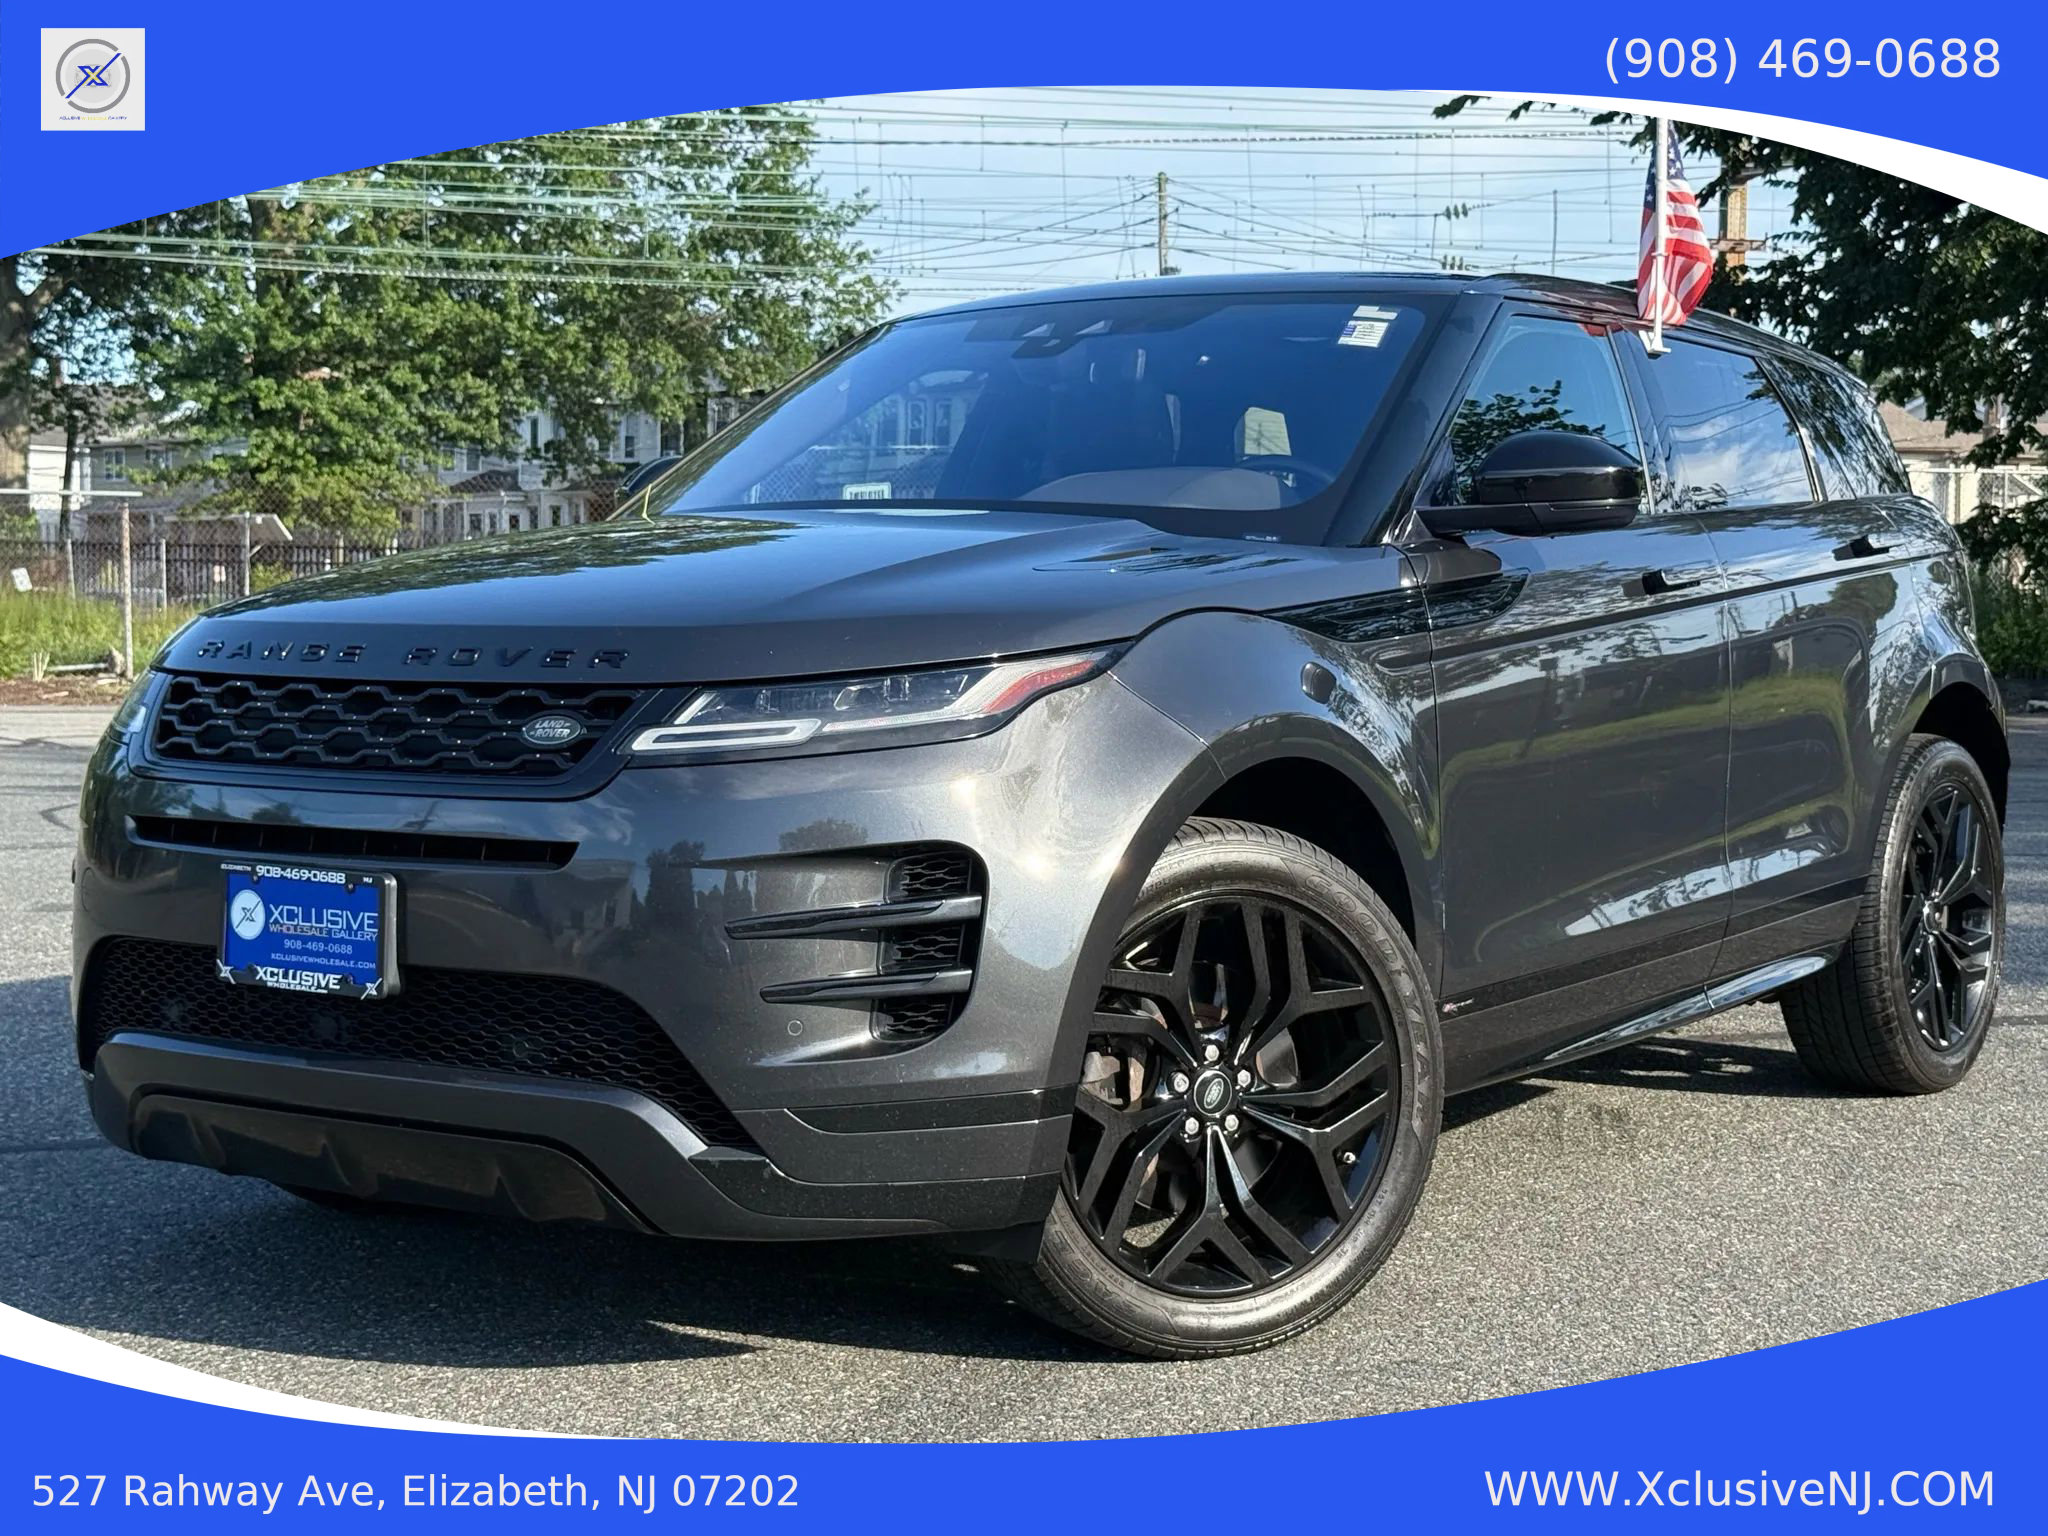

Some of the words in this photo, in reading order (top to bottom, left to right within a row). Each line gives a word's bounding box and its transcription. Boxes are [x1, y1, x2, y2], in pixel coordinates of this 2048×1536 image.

[197, 639, 367, 663] RANGE
[402, 646, 630, 669] ROVER
[534, 728, 571, 738] ROVER
[269, 904, 379, 932] XCLUSIVE
[269, 923, 329, 938] WHOLESALE
[331, 930, 379, 942] GALLERY
[283, 938, 353, 955] 908-469-0688
[271, 953, 376, 969] XCLUSIVEWHOLESALE.COM
[255, 965, 343, 989] XCLUSIVE
